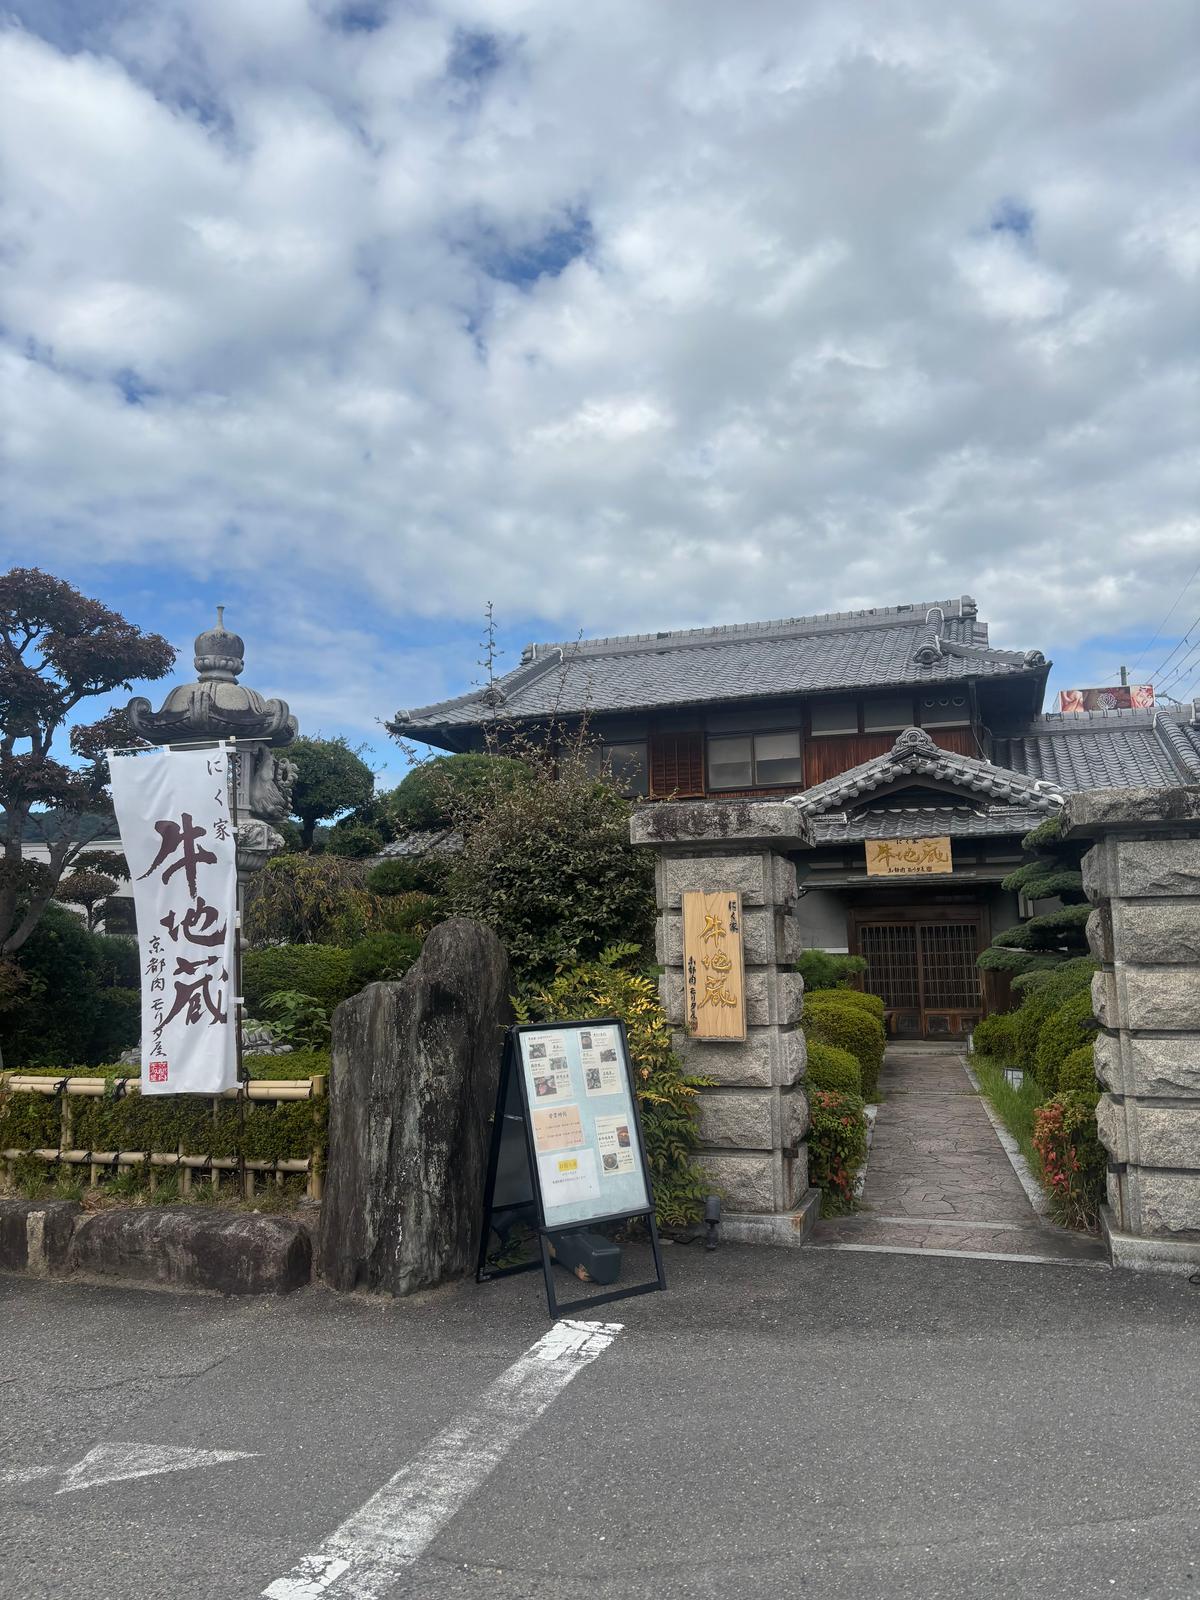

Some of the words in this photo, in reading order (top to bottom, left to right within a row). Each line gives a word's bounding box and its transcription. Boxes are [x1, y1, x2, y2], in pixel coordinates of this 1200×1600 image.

[207, 760, 230, 841] にく家
[136, 812, 229, 1027] 牛地蔵
[697, 914, 738, 1010] 牛地蔵
